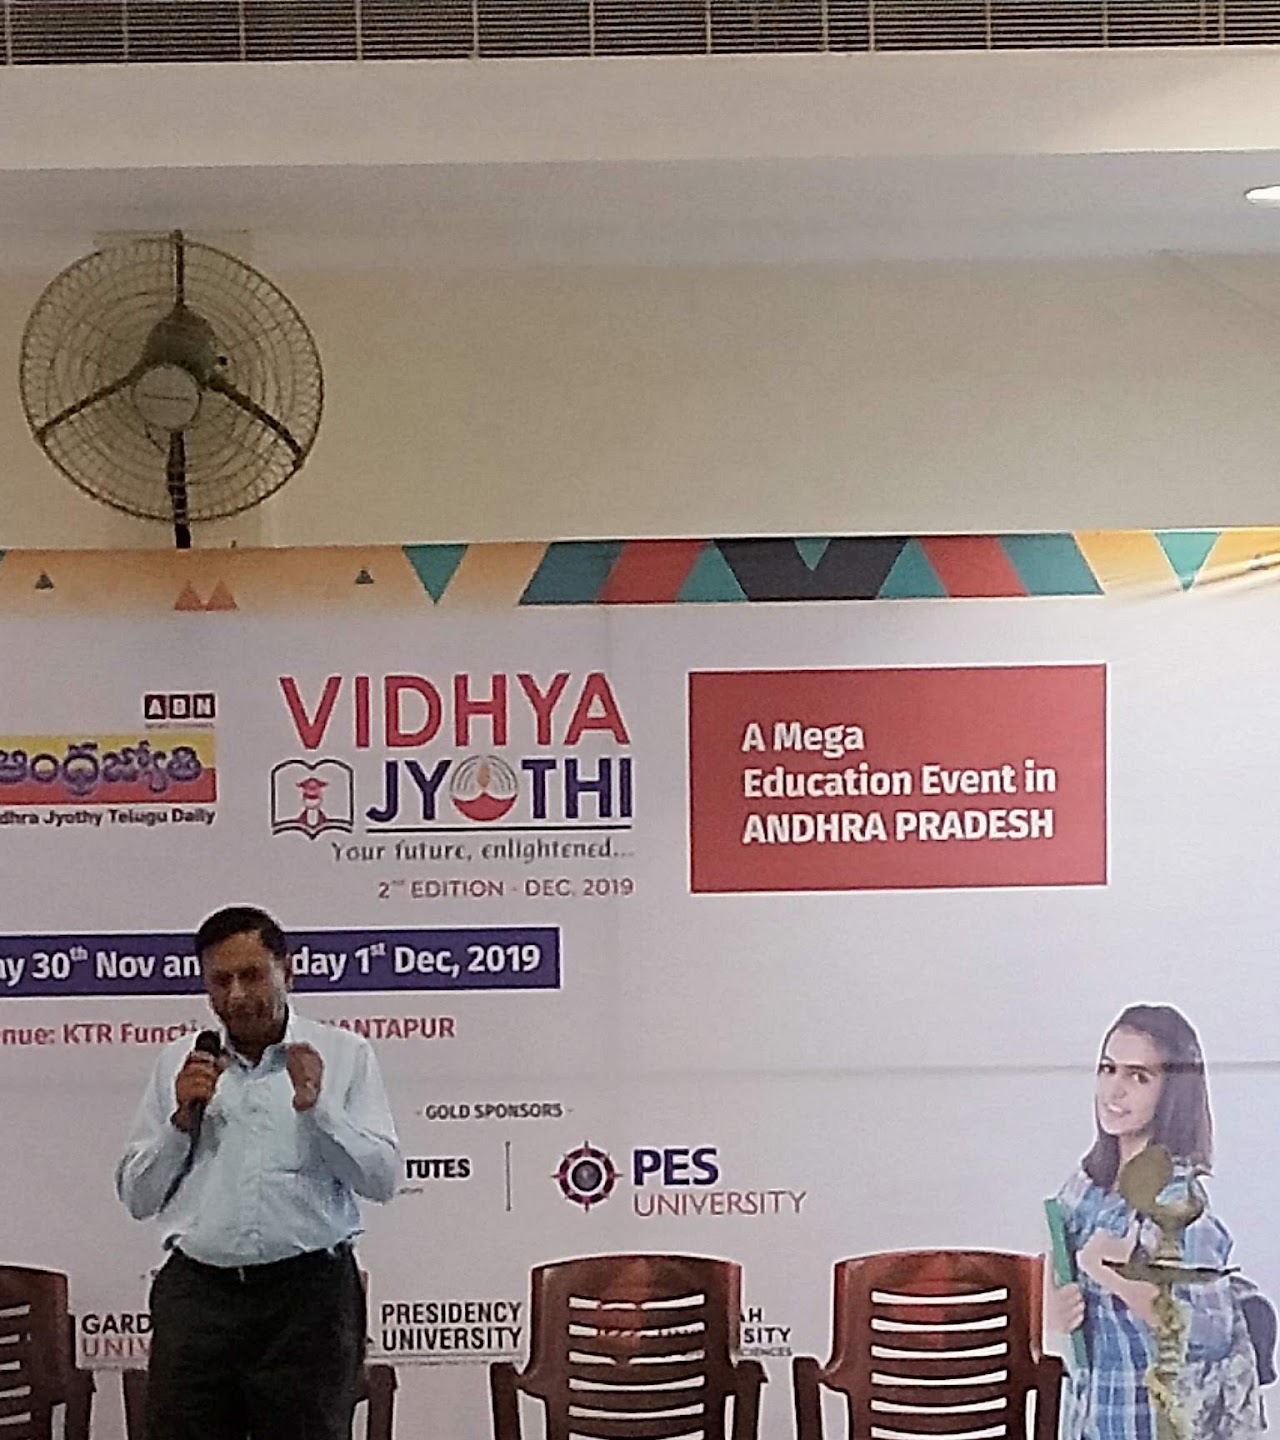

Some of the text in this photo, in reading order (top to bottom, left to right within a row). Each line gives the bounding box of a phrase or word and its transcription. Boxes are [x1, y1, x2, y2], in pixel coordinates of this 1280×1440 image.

[145, 694, 216, 719] ABN
[278, 672, 631, 750] VIDHYA
[742, 722, 865, 759] A Mega
[743, 759, 1057, 798] Education Event in
[43, 808, 103, 827] Jyothy
[108, 807, 168, 827] Telugu
[172, 806, 216, 826] Daily
[742, 808, 1054, 845] ANDHRA PRADESH
[331, 842, 386, 863] Your
[394, 839, 473, 863] future,
[410, 879, 504, 898] EDITION
[583, 877, 634, 897] 2019
[31, 944, 89, 980] 30th
[96, 951, 156, 979] Nov
[164, 953, 202, 978] an
[291, 945, 348, 981] day
[355, 942, 387, 975] 1st
[394, 945, 461, 979] Dec,
[467, 944, 541, 973] 2019
[64, 1022, 113, 1045] KTR
[425, 1102, 564, 1120] GOLD SPONSORS
[633, 1146, 720, 1188] PES
[633, 1190, 808, 1217] UNIVERSITY
[81, 1313, 153, 1336] GARD
[381, 1301, 523, 1325] PRESIDENCY
[382, 1326, 523, 1352] UNIVERSITY
